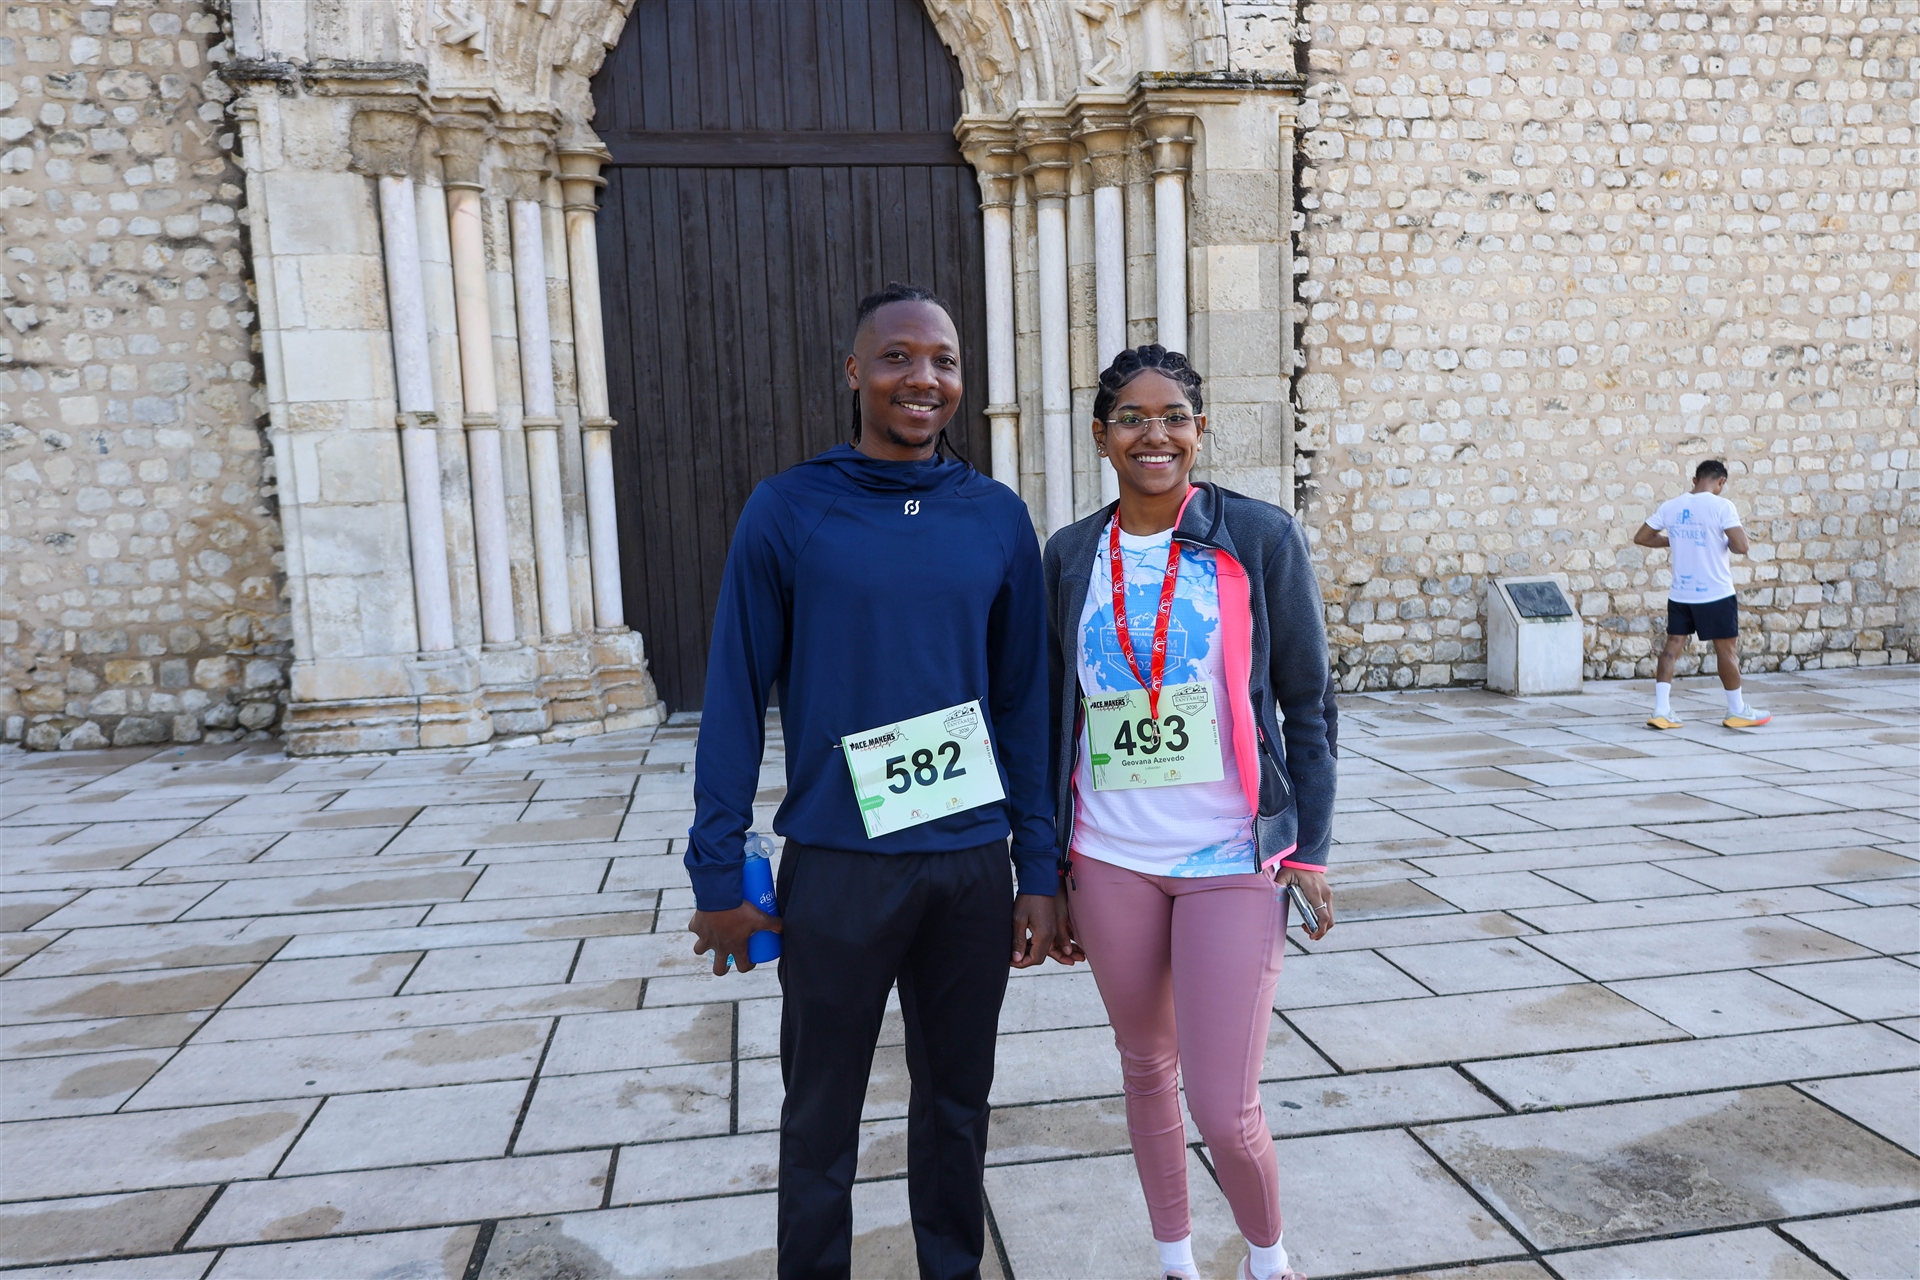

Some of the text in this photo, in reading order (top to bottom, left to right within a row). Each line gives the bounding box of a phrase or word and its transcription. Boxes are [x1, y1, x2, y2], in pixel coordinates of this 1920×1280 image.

[1114, 715, 1189, 756] 493
[886, 740, 967, 794] 582
[1121, 755, 1185, 767] Geovana Azevedo
